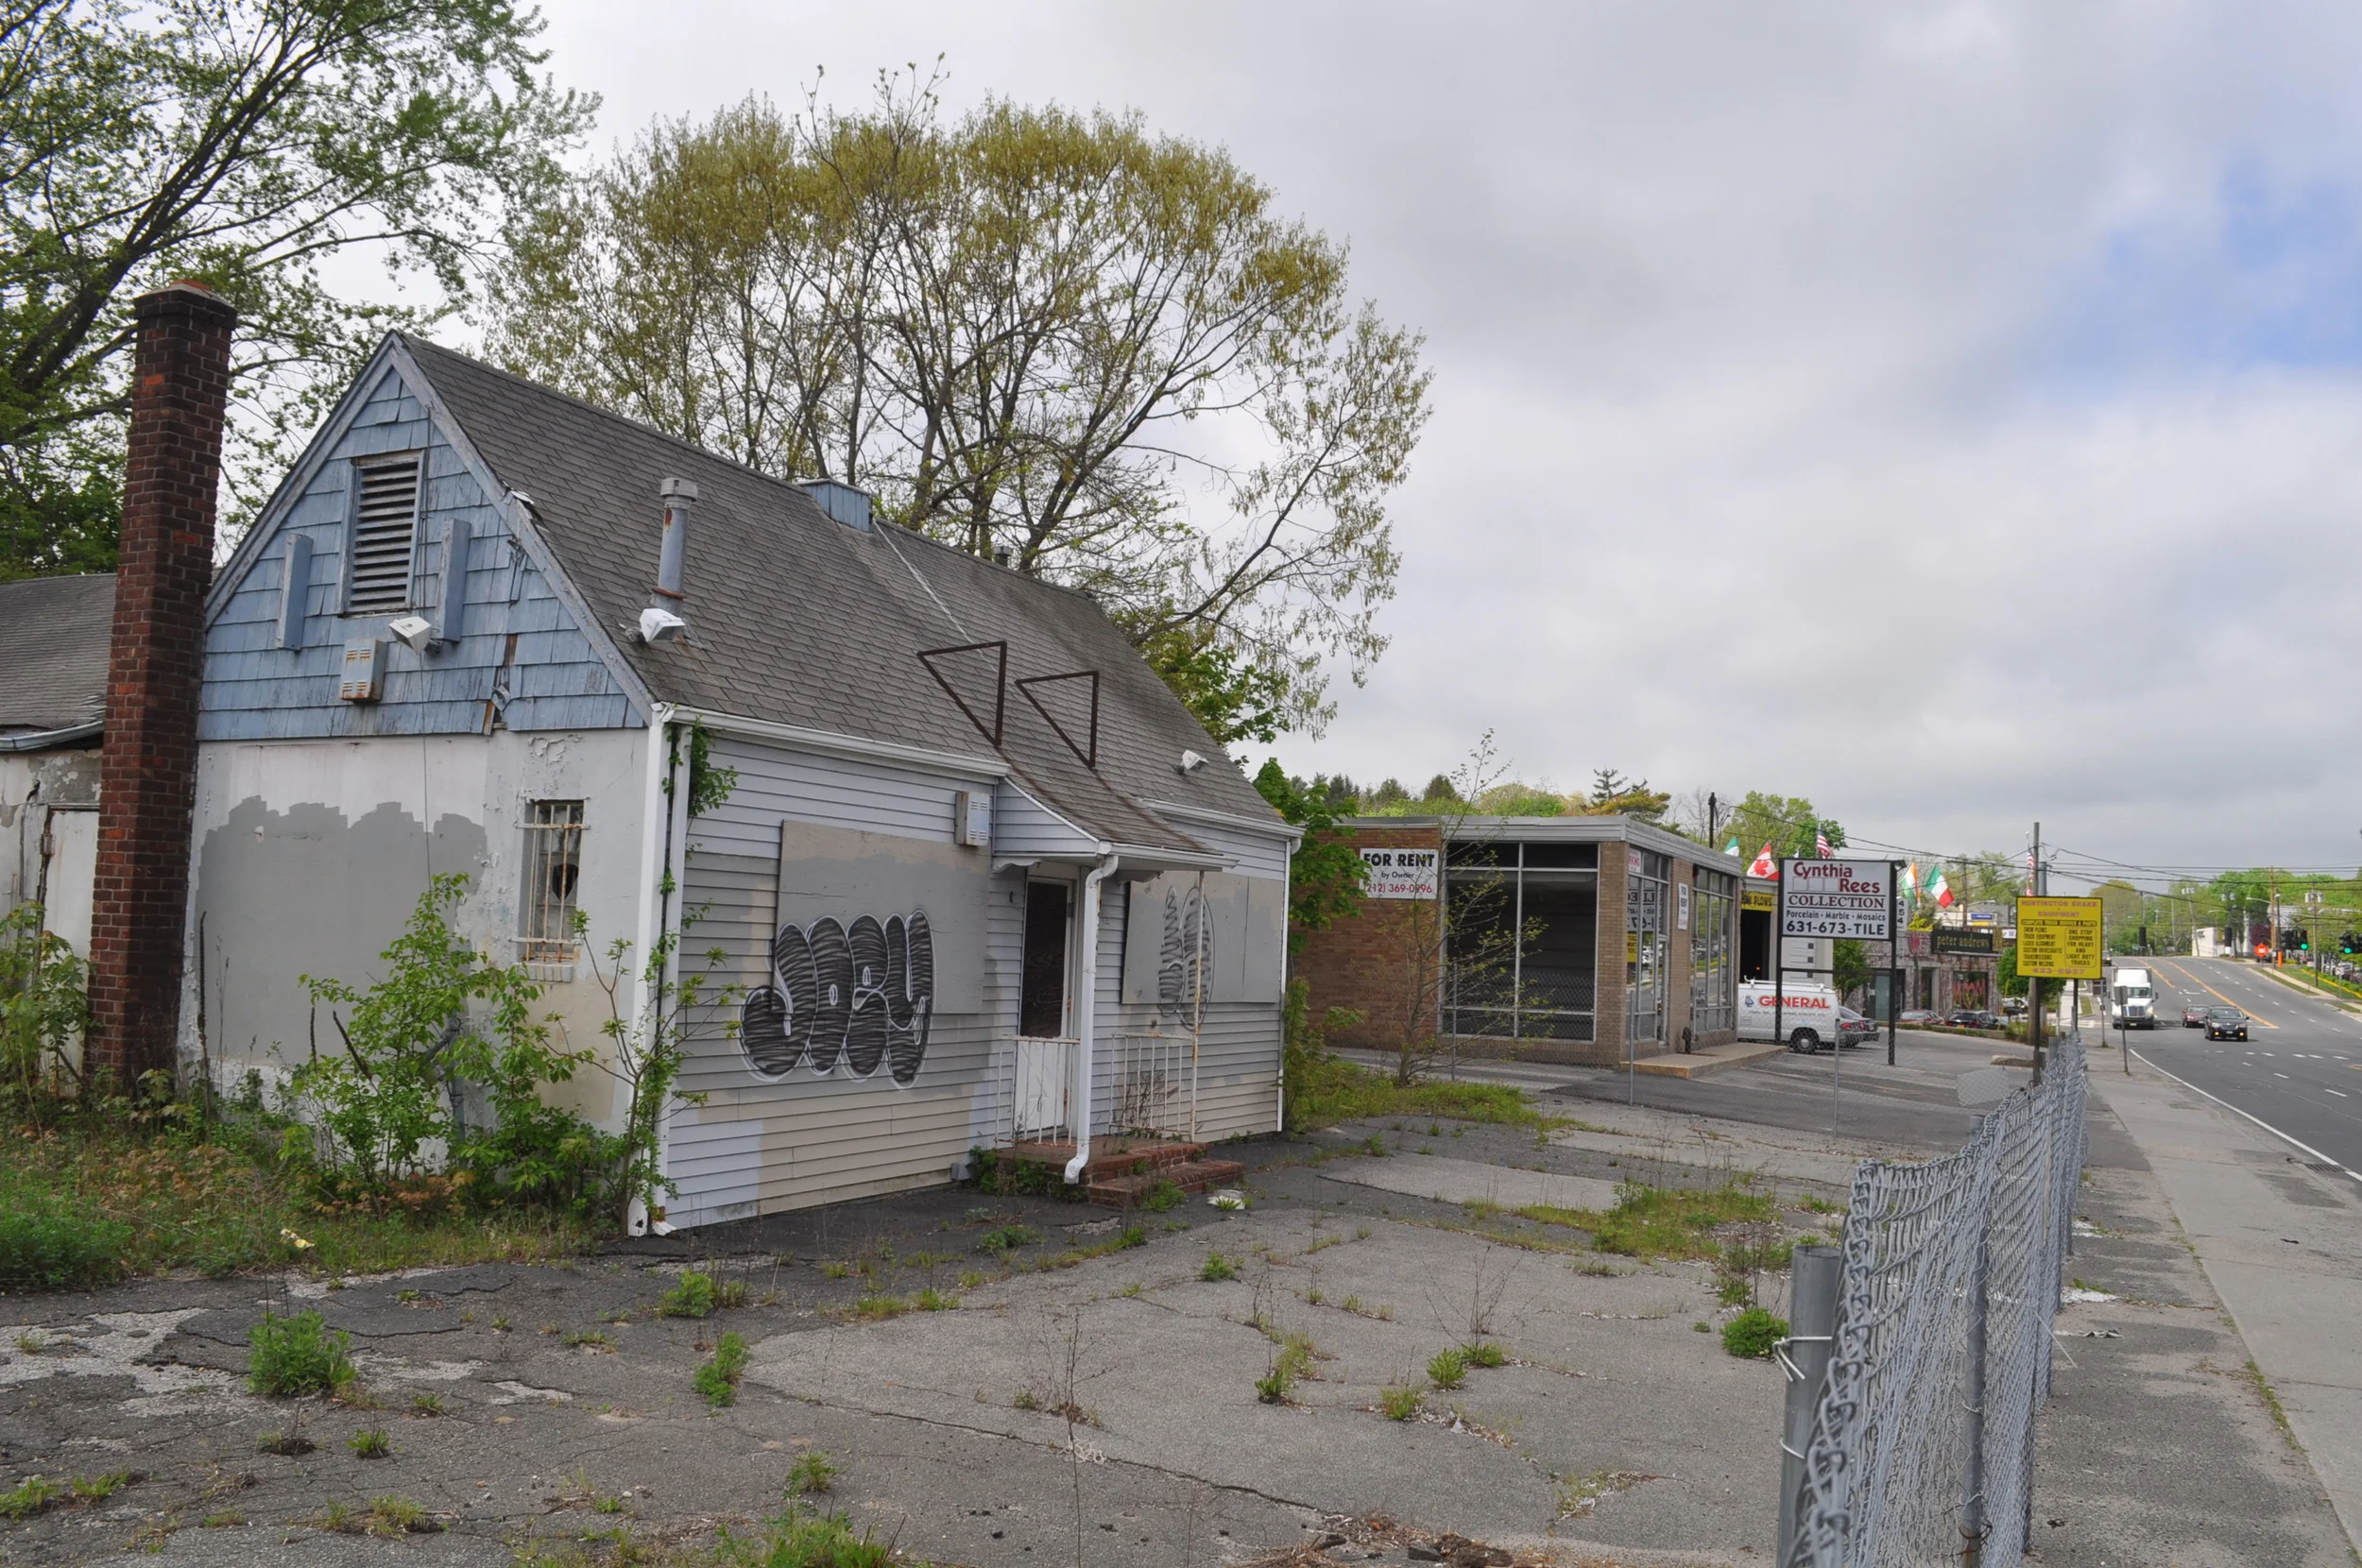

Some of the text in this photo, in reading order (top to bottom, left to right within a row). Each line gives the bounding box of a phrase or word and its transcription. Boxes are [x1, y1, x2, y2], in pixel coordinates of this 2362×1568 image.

[1363, 853, 1435, 867] FOR RENT
[1381, 871, 1390, 879] by
[1793, 861, 1853, 879] Cynthia
[1839, 878, 1880, 894] Rees
[1789, 895, 1885, 909] COLLECTION
[1787, 910, 1886, 921] Porcelain Marble Mosaics
[1787, 920, 1885, 935] 631-673-TILE
[1937, 935, 1957, 948] peter
